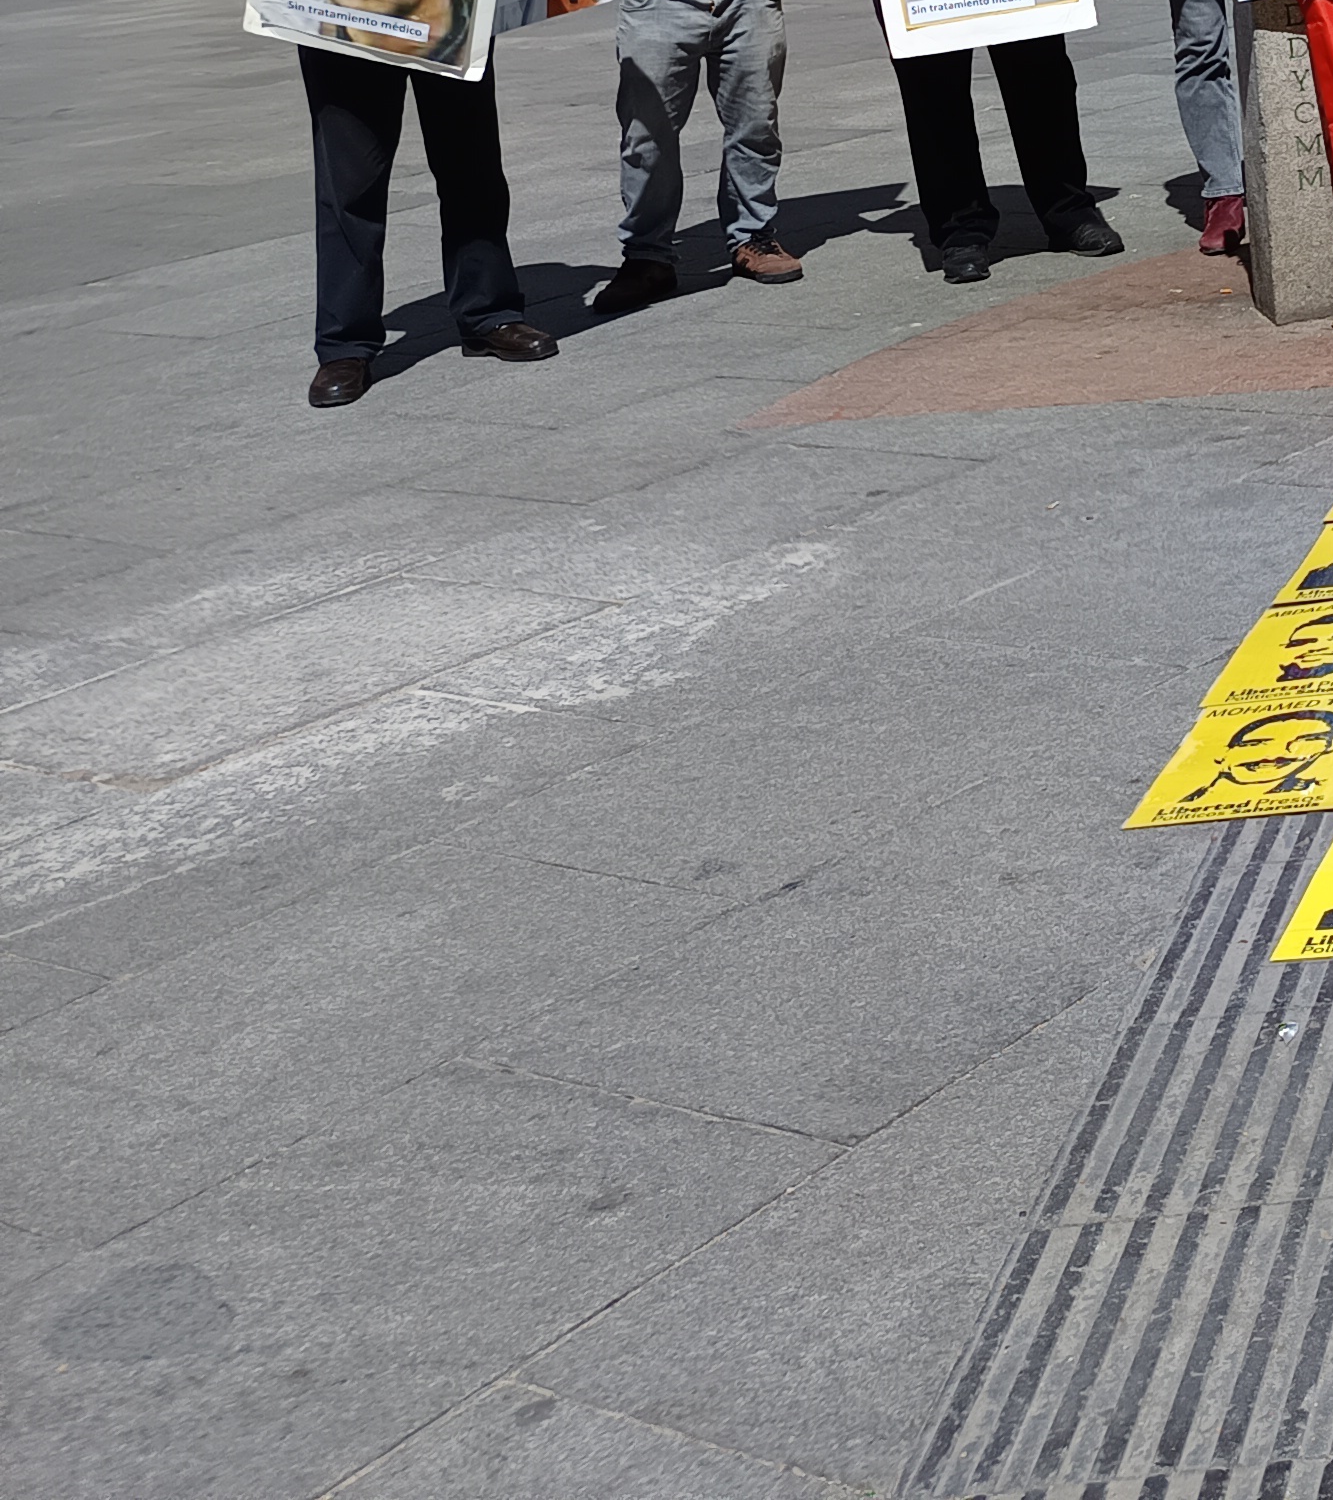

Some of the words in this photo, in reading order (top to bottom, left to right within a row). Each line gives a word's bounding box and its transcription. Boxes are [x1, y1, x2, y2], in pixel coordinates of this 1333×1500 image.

[288, 1, 304, 12] Sin
[308, 4, 378, 27] tratamiento
[381, 19, 422, 37] médico
[912, 5, 926, 15] Sin
[1206, 698, 1322, 719] MOHAMED
